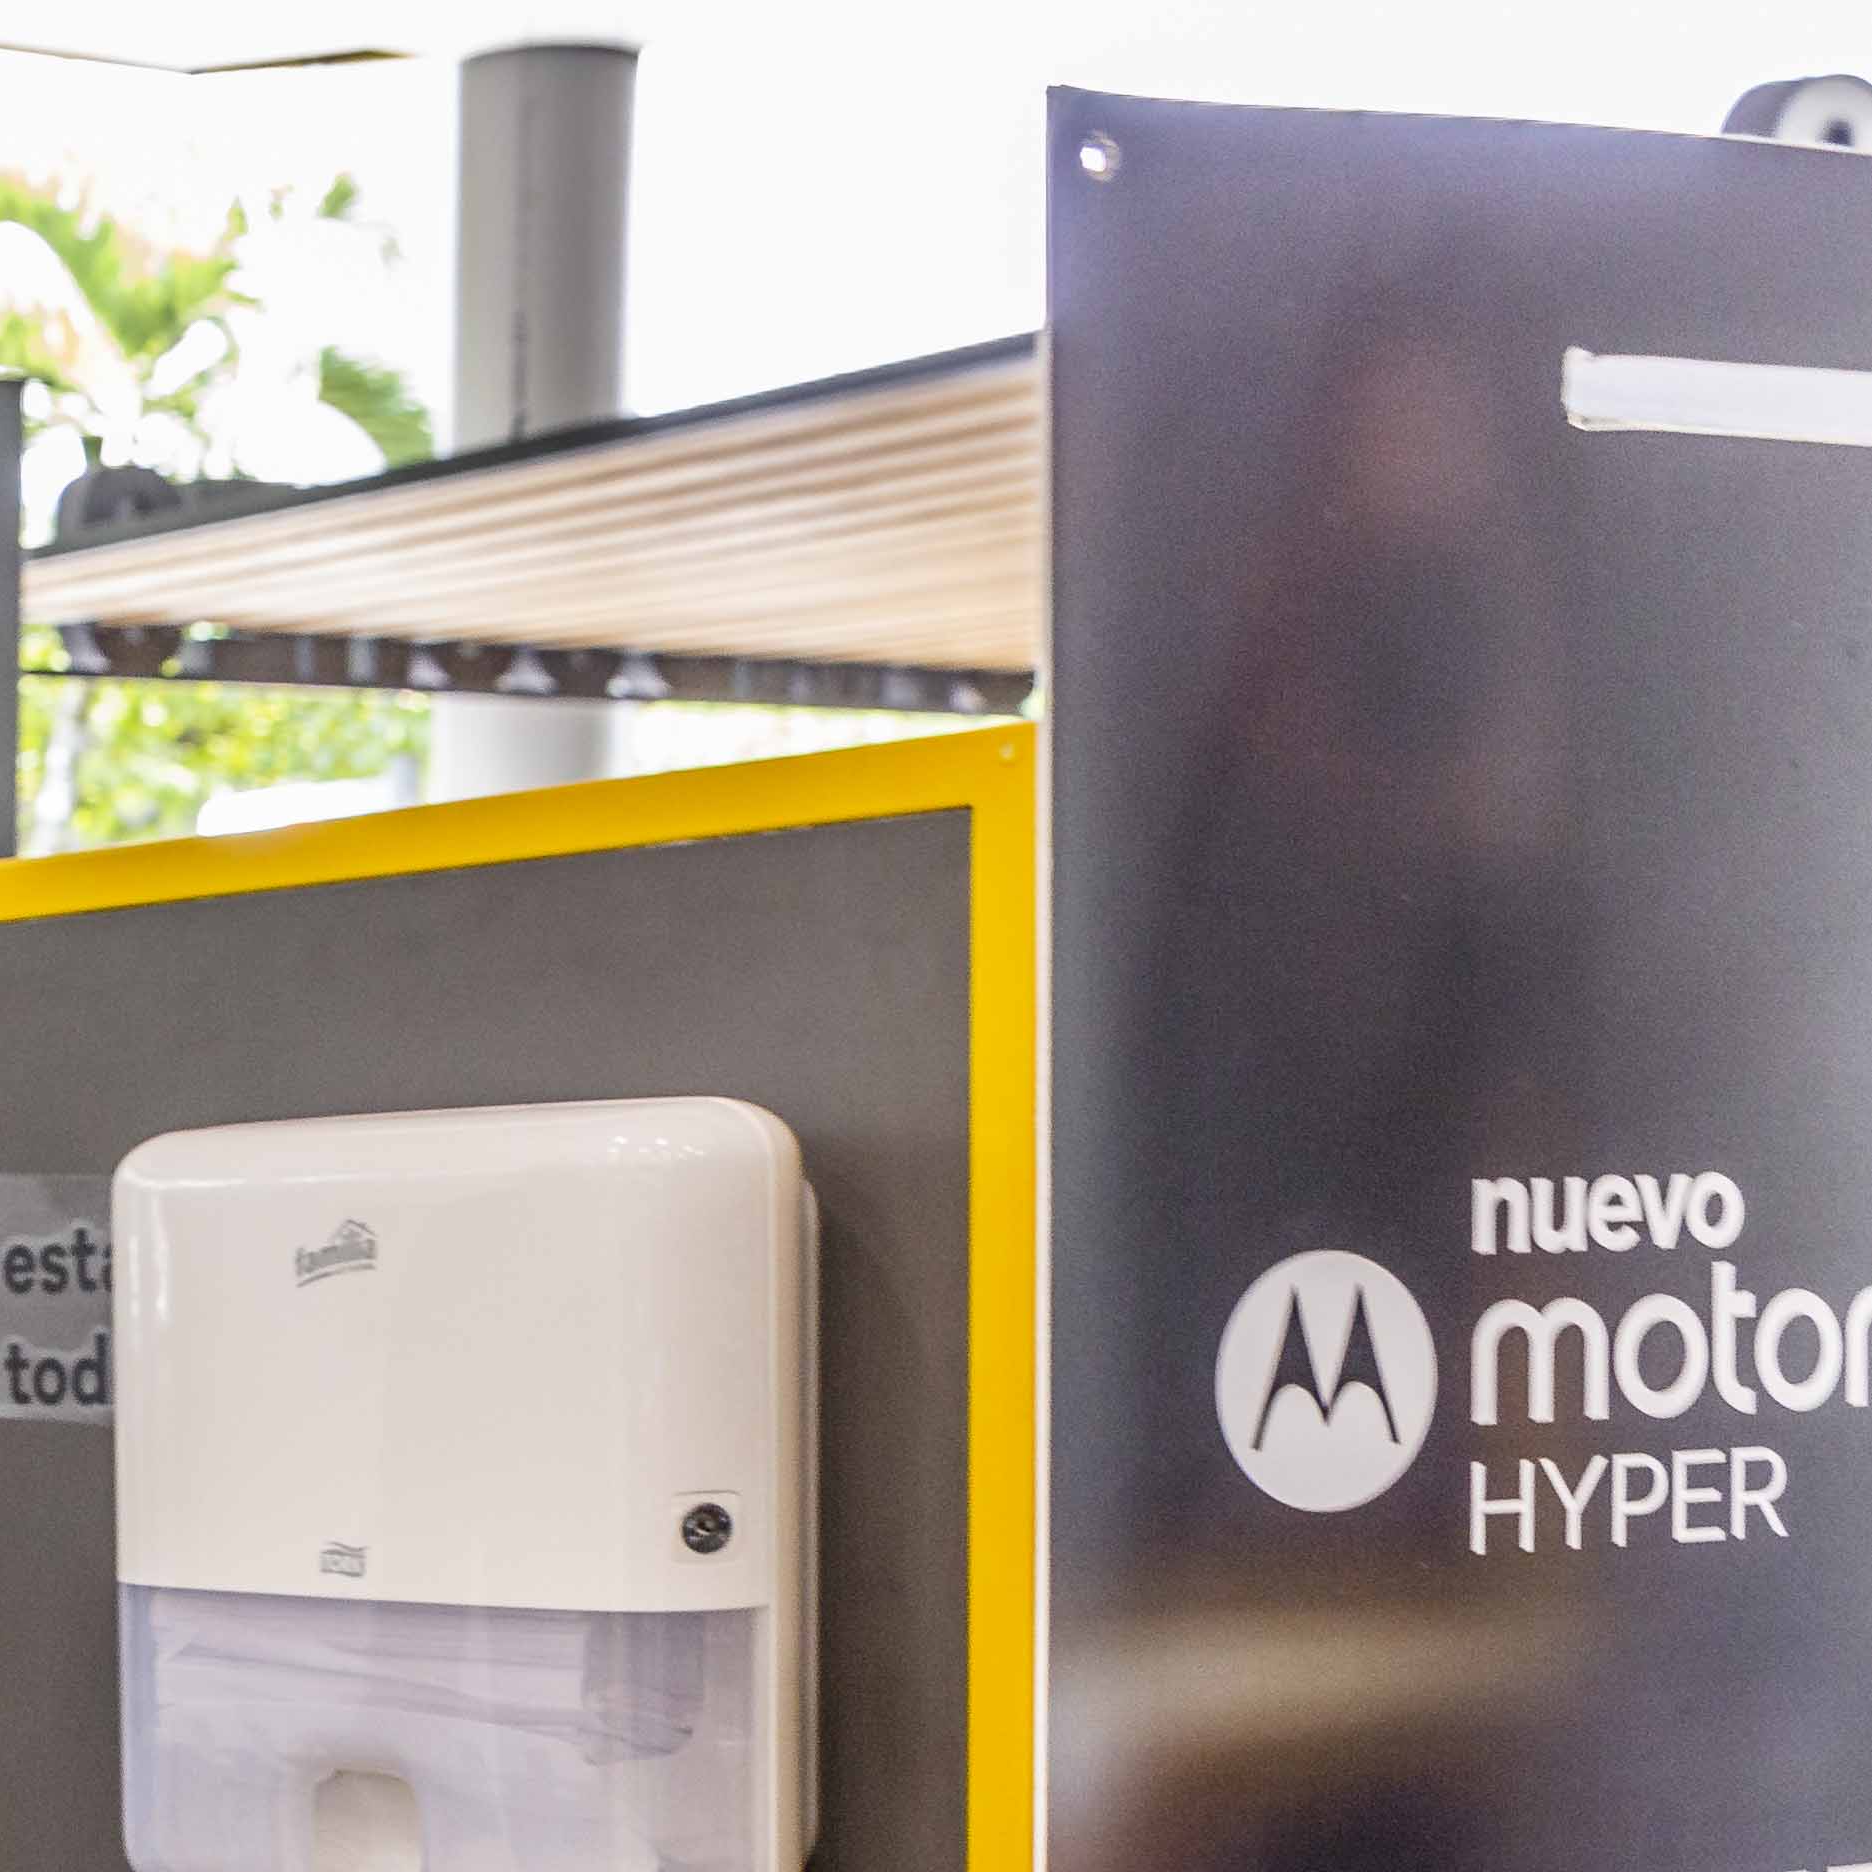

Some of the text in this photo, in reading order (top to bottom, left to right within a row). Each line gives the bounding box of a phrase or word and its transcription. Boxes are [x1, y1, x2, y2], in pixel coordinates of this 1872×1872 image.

[1469, 1170, 1746, 1256] nuevo
[2, 1226, 112, 1295] est
[1468, 1445, 1790, 1556] HYPER
